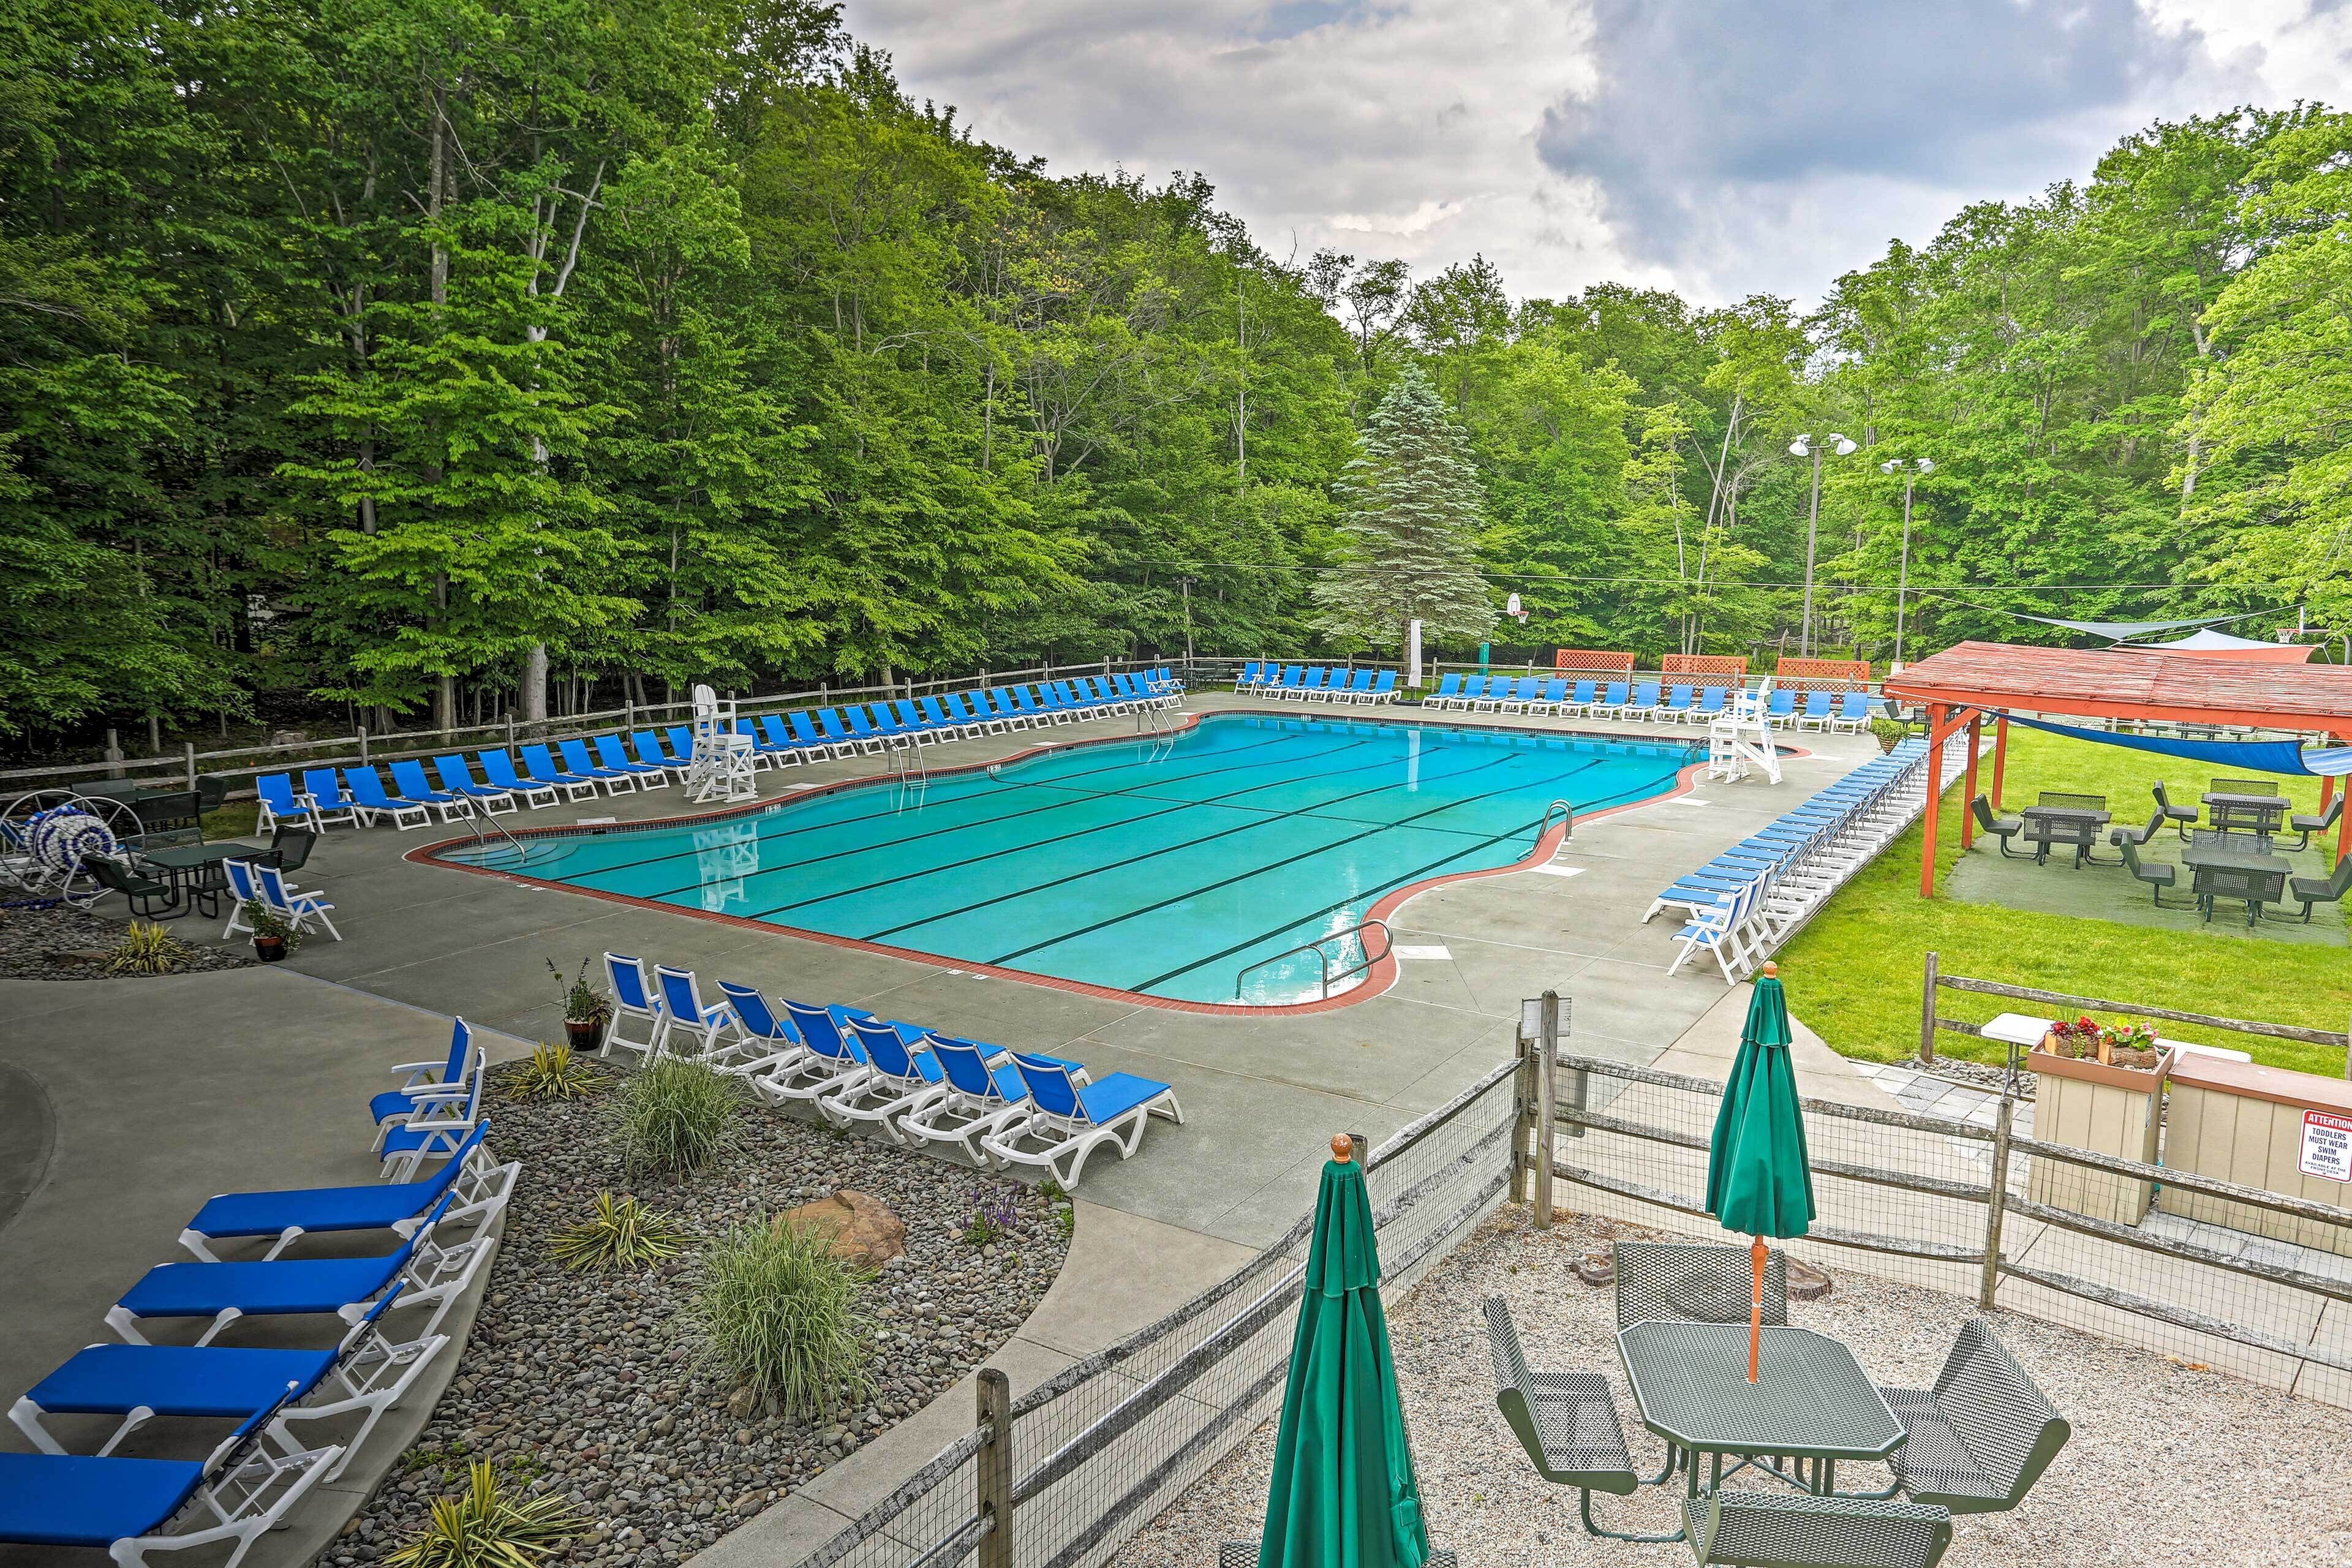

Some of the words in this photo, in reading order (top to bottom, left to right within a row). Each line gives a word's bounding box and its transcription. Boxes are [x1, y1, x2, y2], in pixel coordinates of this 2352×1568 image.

[2308, 1114, 2352, 1130] ATTENTION
[2312, 1128, 2346, 1140] TODDLERS
[2309, 1136, 2327, 1145] MUST
[2329, 1139, 2348, 1150] WEAR
[2318, 1146, 2337, 1156] SWIM
[2312, 1153, 2340, 1165] DIAPERS
